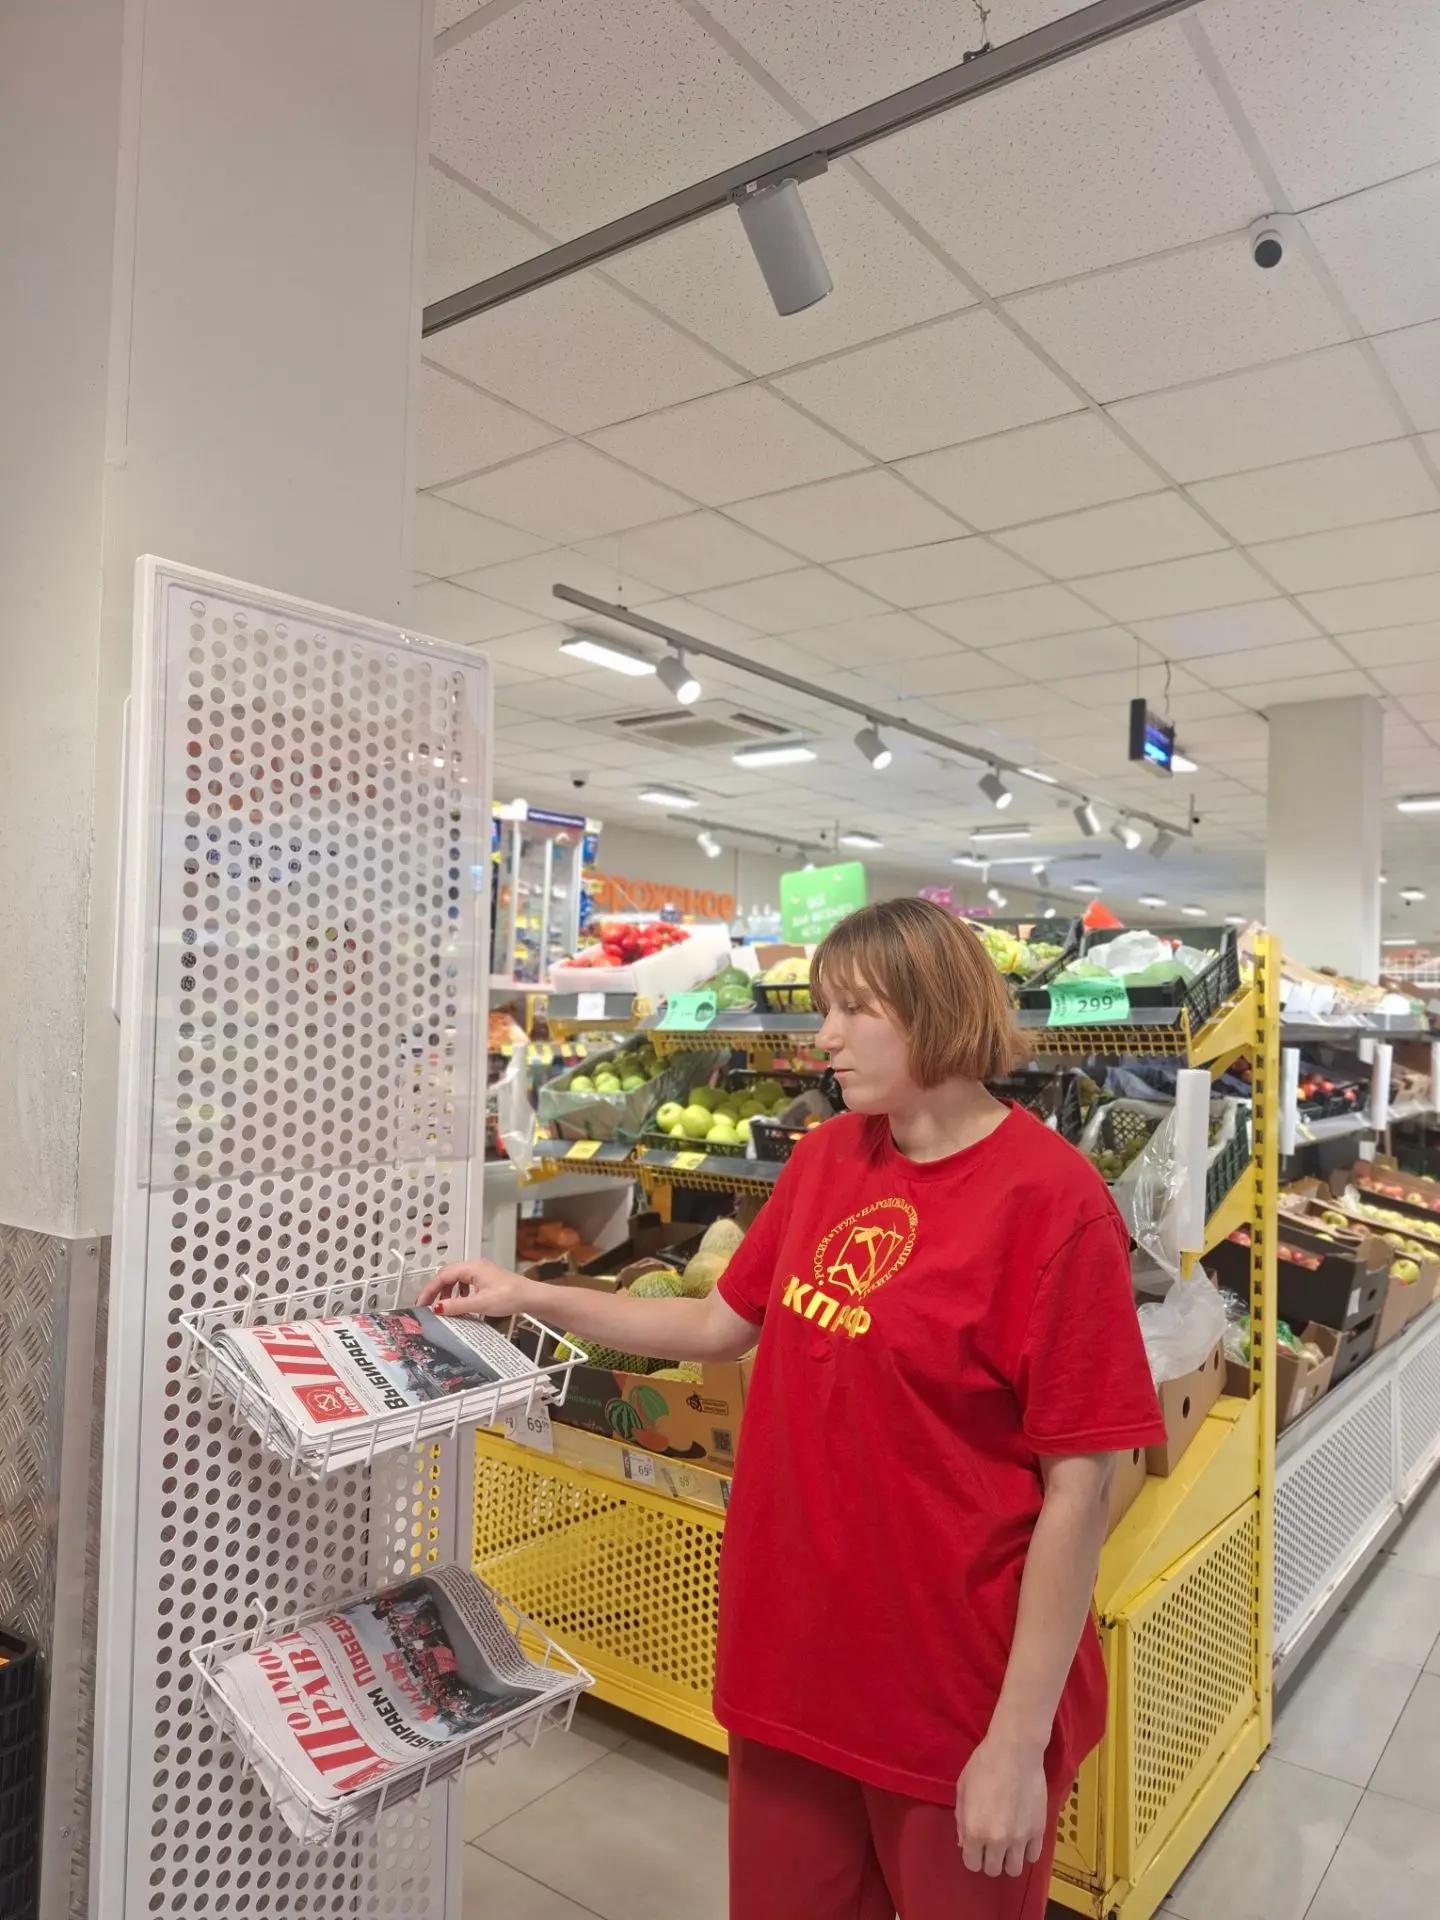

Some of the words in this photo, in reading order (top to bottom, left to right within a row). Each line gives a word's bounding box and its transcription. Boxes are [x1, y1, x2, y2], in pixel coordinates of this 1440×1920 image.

[1077, 995, 1113, 1014] 299
[813, 1236, 831, 1281] РОССИЯ
[832, 1213, 858, 1235] ТРУД
[333, 1328, 409, 1411] ВЫБИРАЕМ
